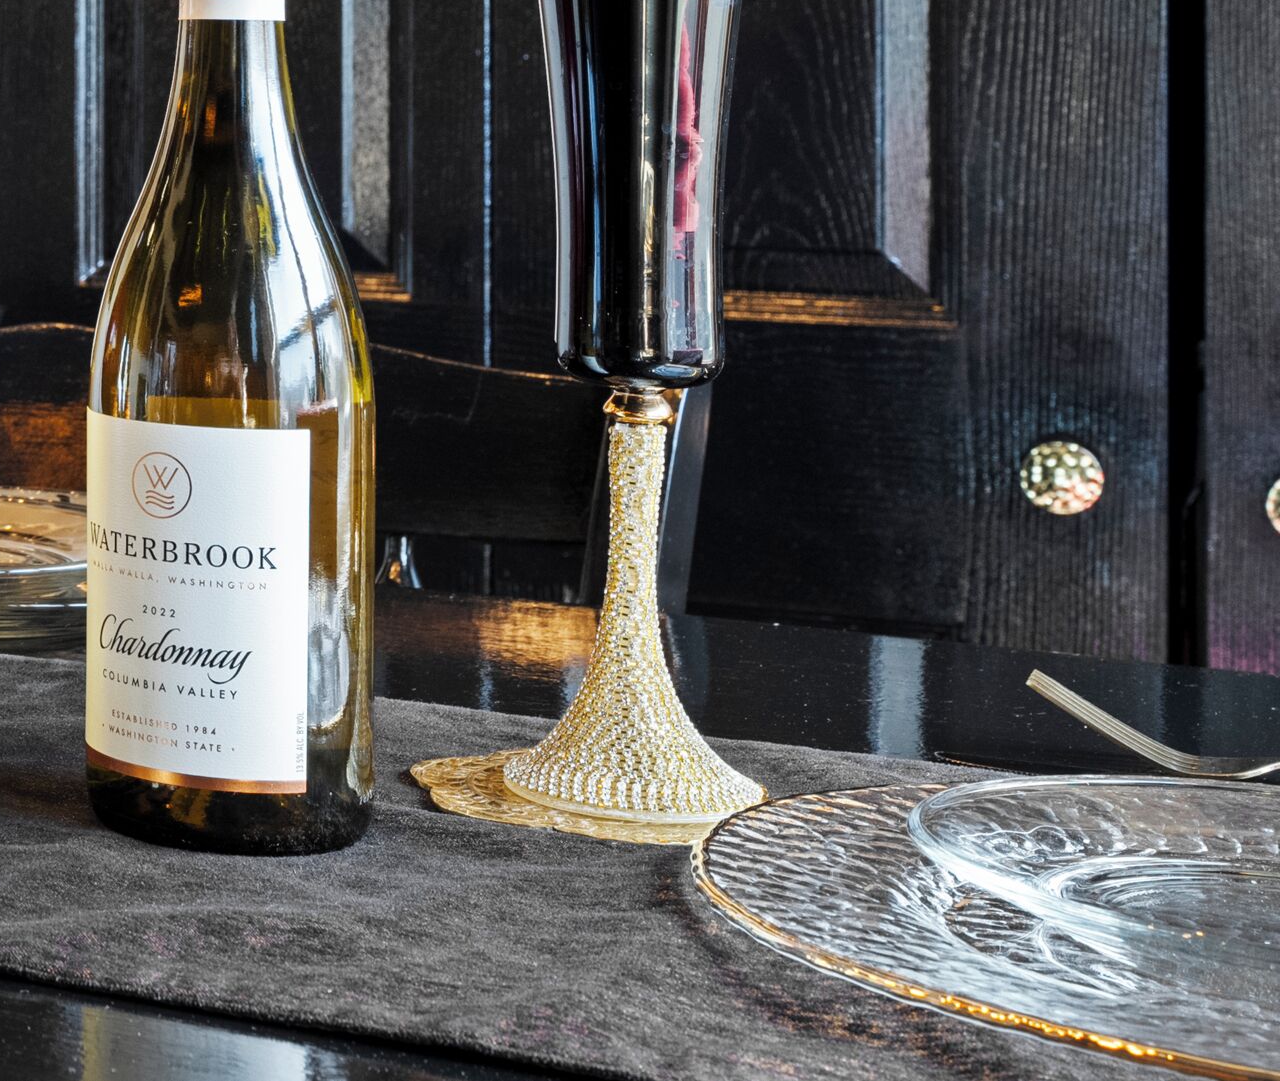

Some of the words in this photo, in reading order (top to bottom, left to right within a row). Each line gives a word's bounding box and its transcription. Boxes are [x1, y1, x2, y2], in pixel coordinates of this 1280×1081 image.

[90, 521, 277, 570] WATERBROOK
[168, 575, 267, 591] WASHINGTON
[142, 605, 176, 618] 2022
[100, 614, 253, 685] Chardonnay
[103, 668, 167, 692] COLUMBIA
[177, 685, 238, 700] VALLEY
[111, 709, 178, 731] ESTABLISHED
[185, 724, 217, 735] 1984
[108, 724, 178, 748] WASHINGTON
[185, 741, 222, 753] STATE
